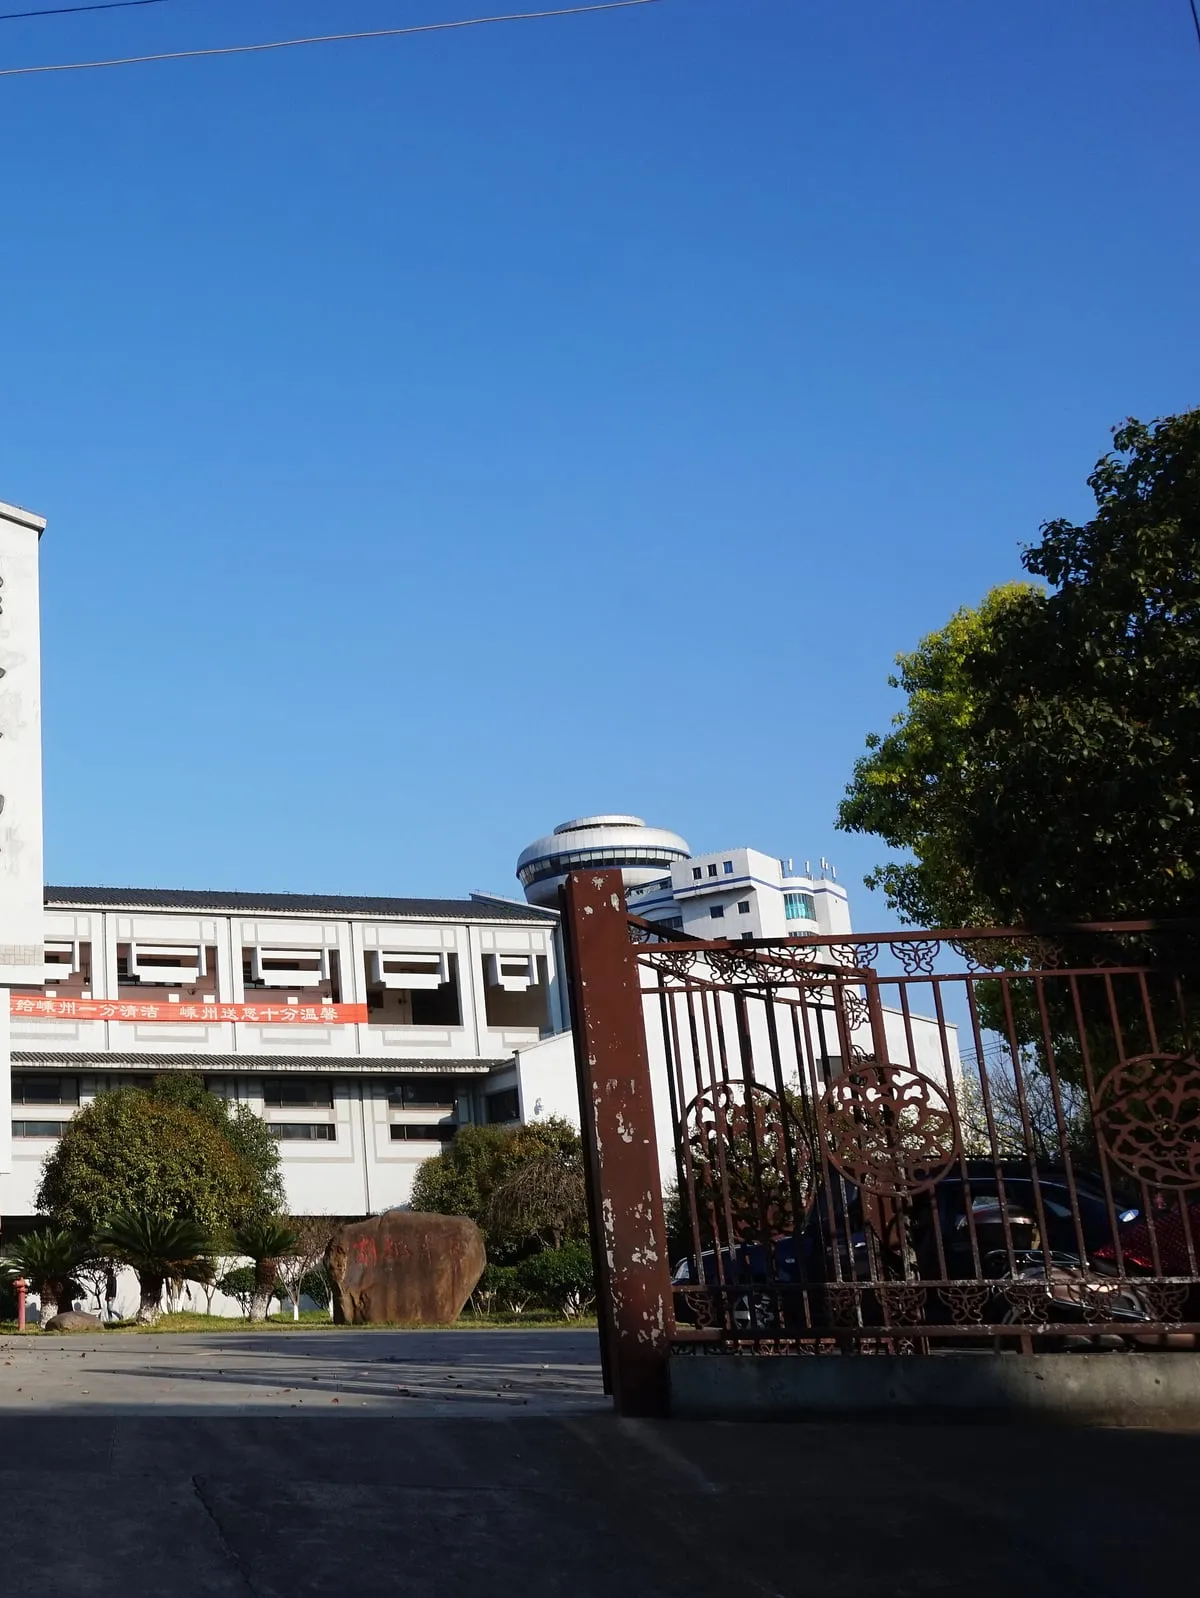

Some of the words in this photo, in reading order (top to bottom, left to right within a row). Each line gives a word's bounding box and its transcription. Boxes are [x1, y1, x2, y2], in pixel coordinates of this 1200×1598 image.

[10, 999, 160, 1018] 给嵊州一分清洁
[179, 1006, 339, 1021] 嵊州送您十分温馨
